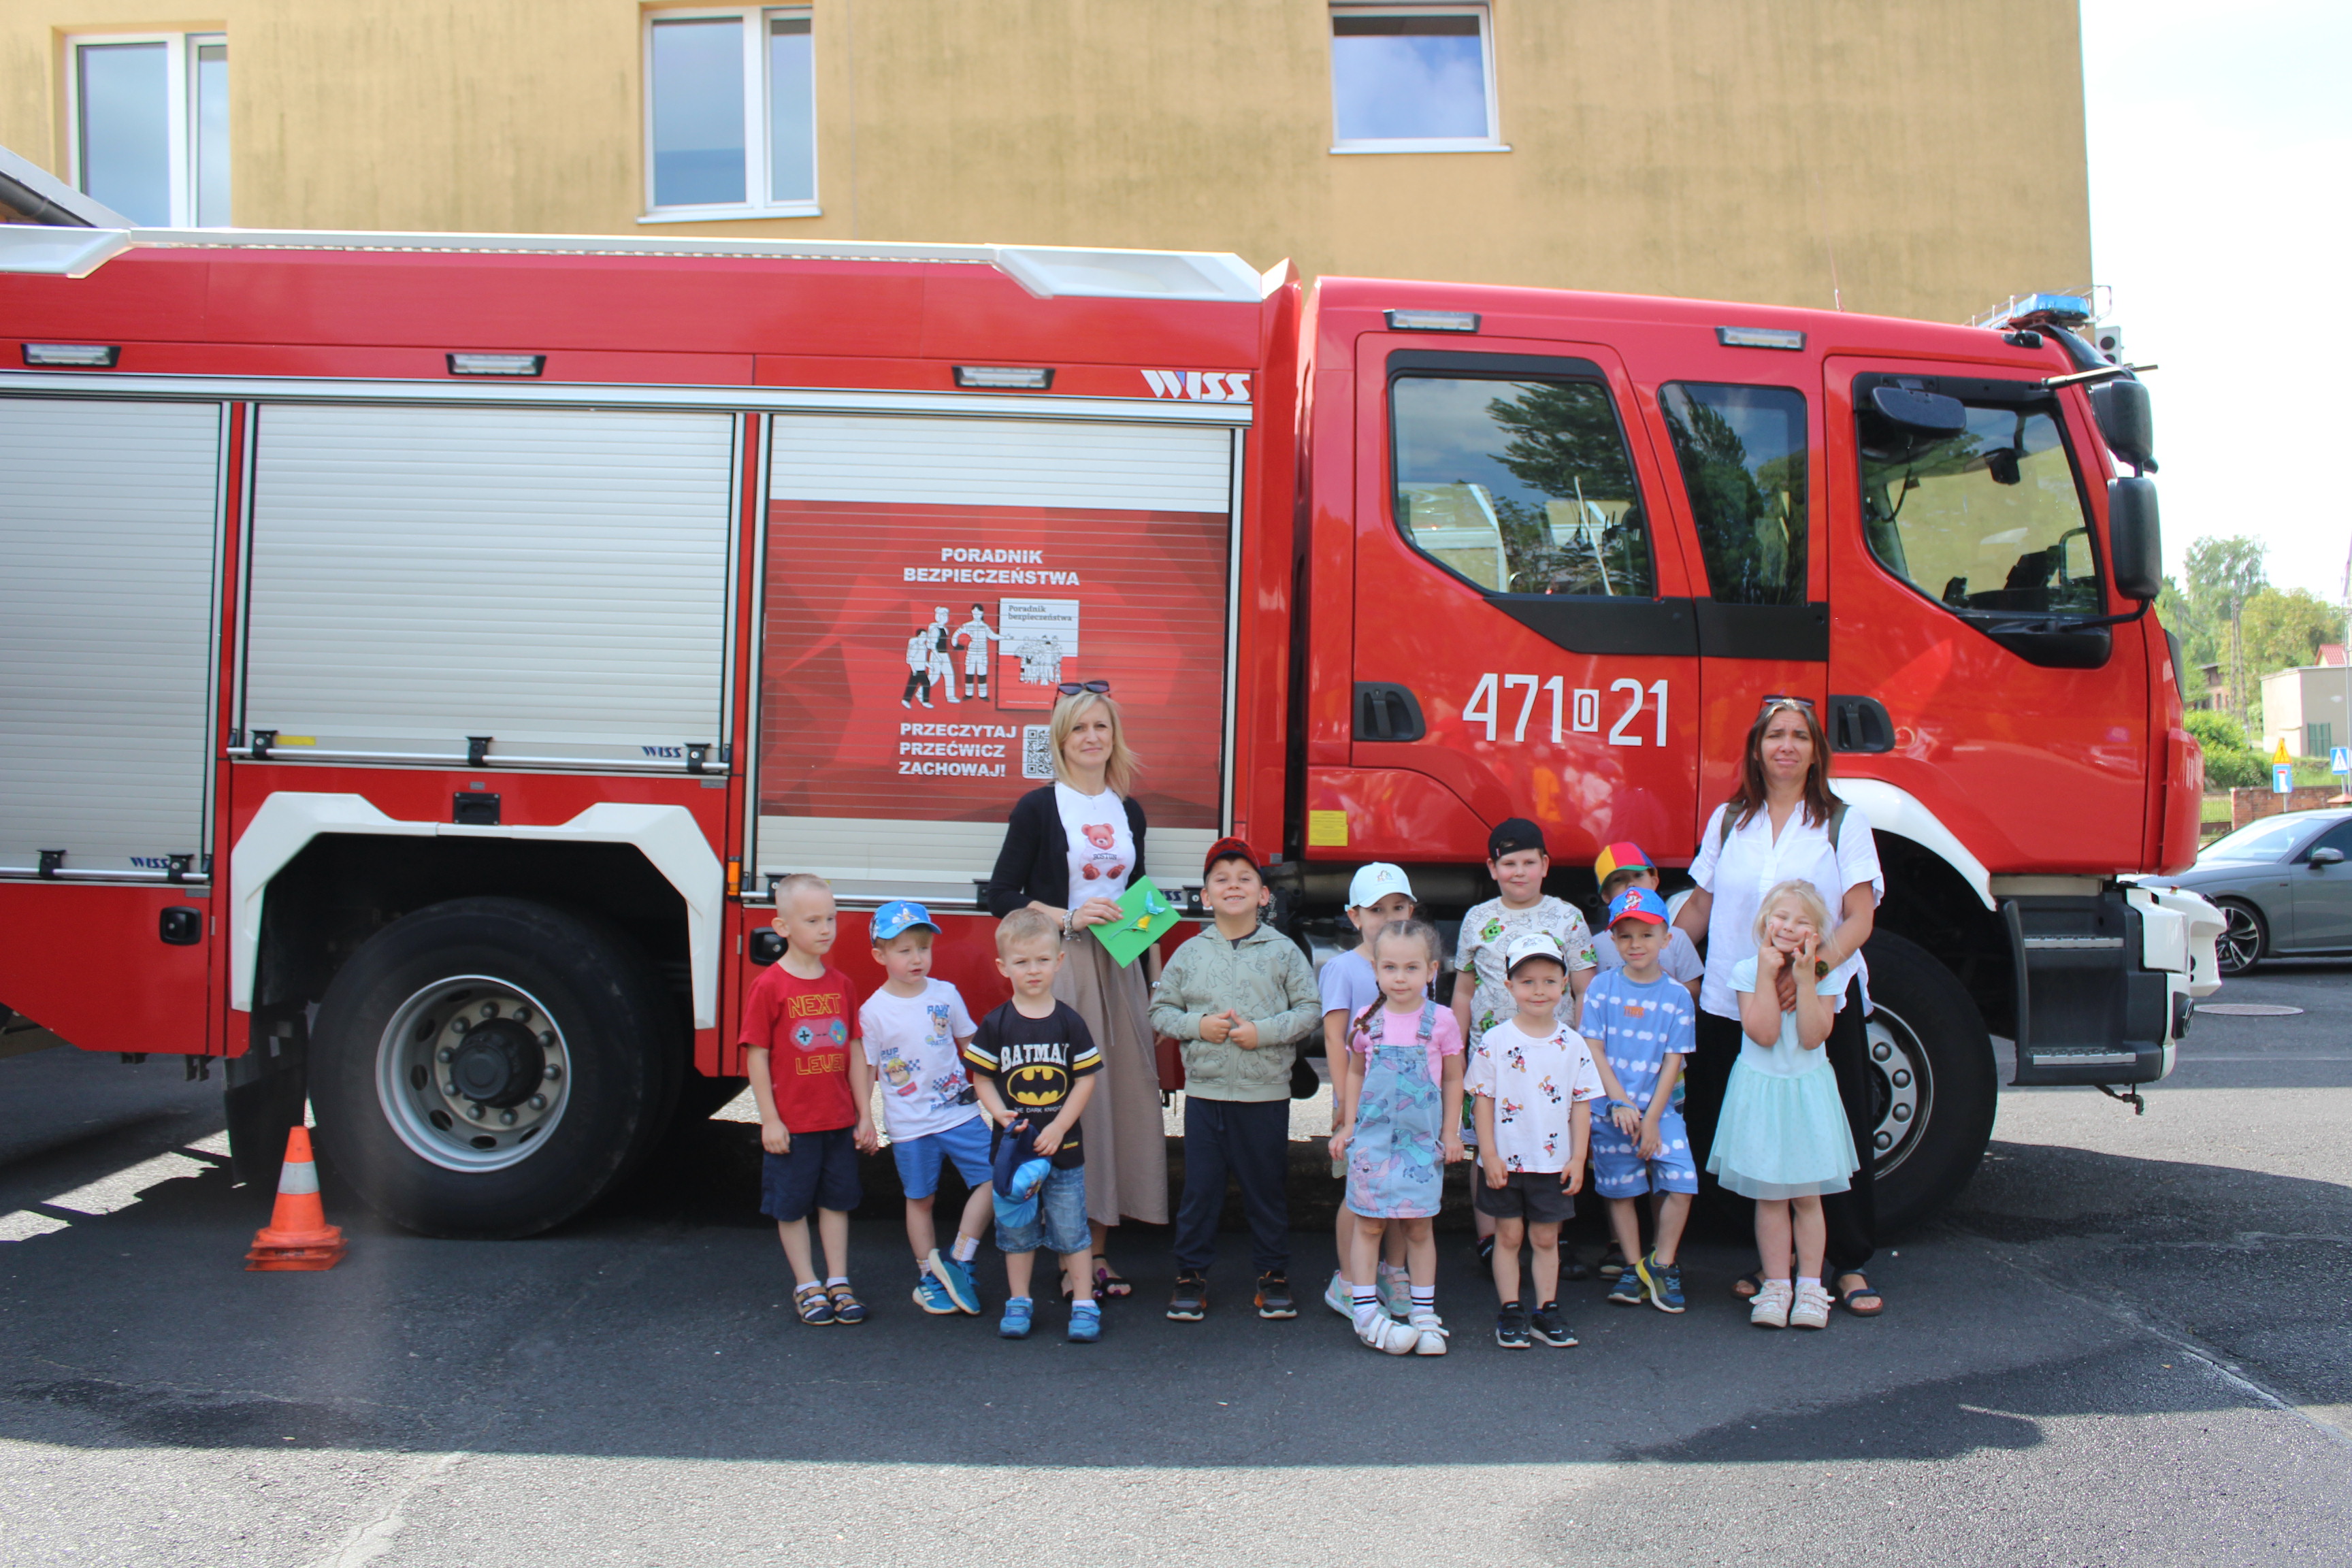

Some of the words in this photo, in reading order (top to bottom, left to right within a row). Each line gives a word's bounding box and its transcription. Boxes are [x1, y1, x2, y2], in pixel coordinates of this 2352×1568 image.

[1140, 370, 1251, 401] WISS
[941, 547, 1043, 564] PORADNIK
[903, 567, 1080, 586] BEZPIECZEŃSTWA
[1008, 613, 1072, 621] bezpieczeństwa
[1463, 673, 1564, 743] 471
[1609, 678, 1668, 747] 21
[900, 723, 1017, 738] PRZECZYTAJ
[641, 746, 681, 757] WISS
[899, 740, 1005, 757] PRZEĆWICZ
[898, 762, 1006, 777] ZACHOWAJ!
[130, 857, 169, 869] WISS
[787, 993, 841, 1019] NEXT
[795, 1054, 845, 1075] LEVE
